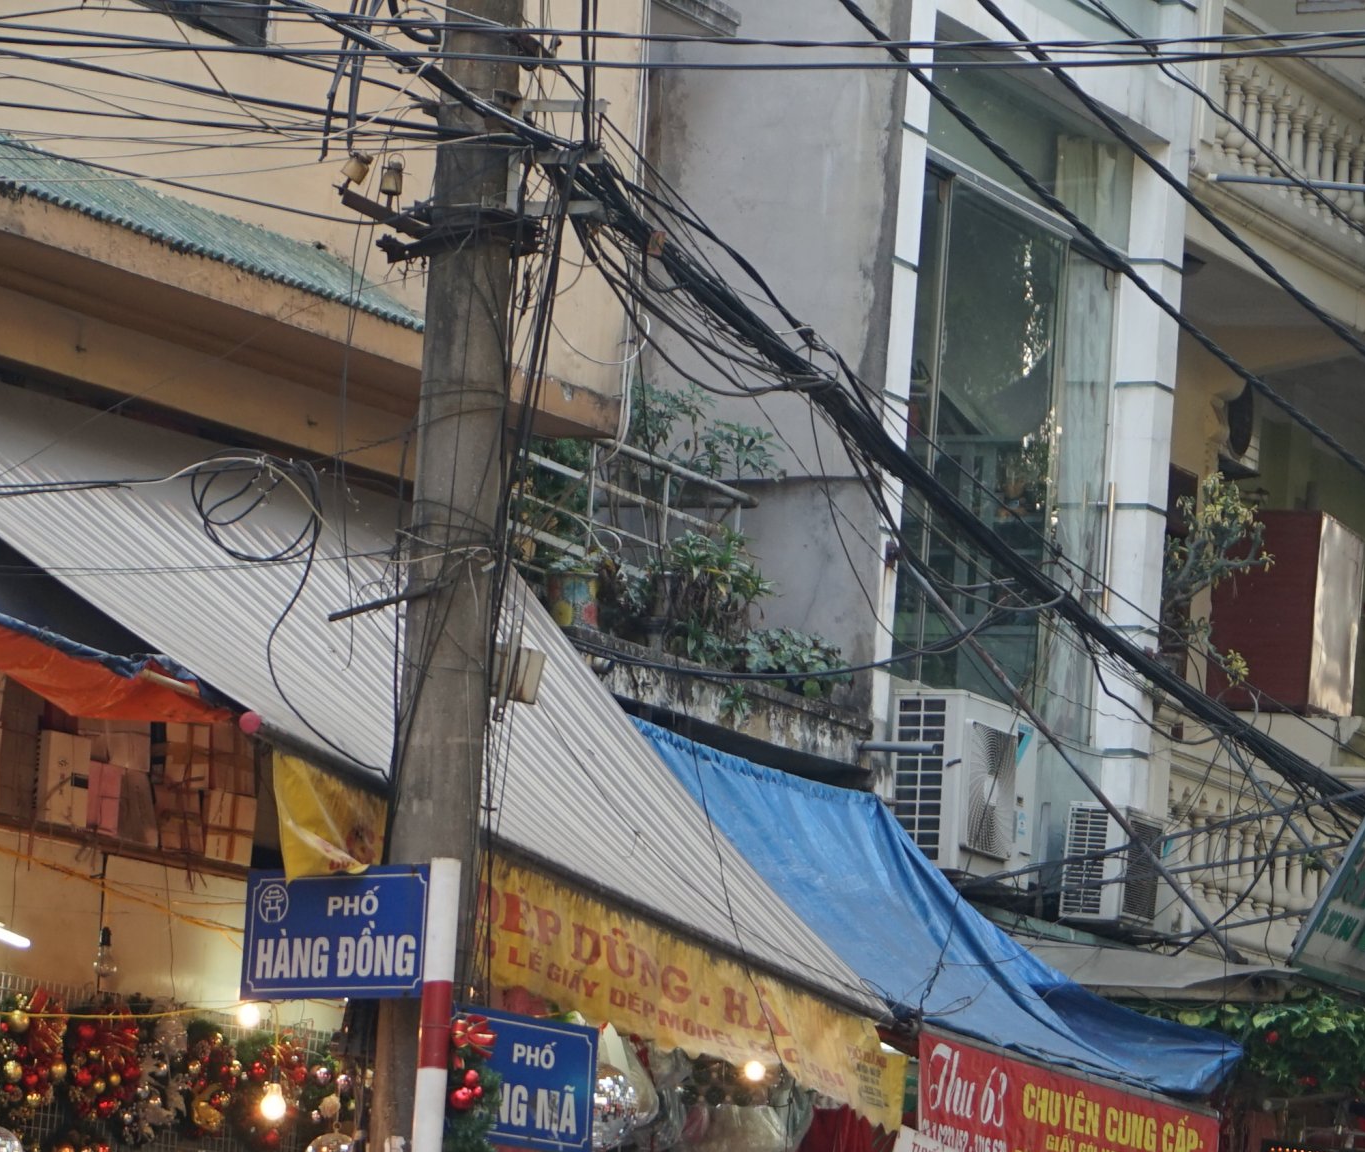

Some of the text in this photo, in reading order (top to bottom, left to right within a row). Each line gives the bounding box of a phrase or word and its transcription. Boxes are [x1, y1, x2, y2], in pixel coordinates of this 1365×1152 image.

[327, 885, 381, 917] PHỐ
[255, 928, 330, 980] HÀNG
[336, 920, 417, 978] ĐỒNG
[571, 921, 692, 1003] DŨNG
[609, 985, 657, 1019] DÉP
[658, 1008, 743, 1049] MODEL
[512, 1042, 557, 1070] PHỐ
[928, 1042, 976, 1120] Thu
[980, 1066, 1009, 1128] 63
[535, 1084, 577, 1135] MÃ
[1022, 1082, 1101, 1139] CHUYÊN
[1104, 1106, 1157, 1152] CUNG
